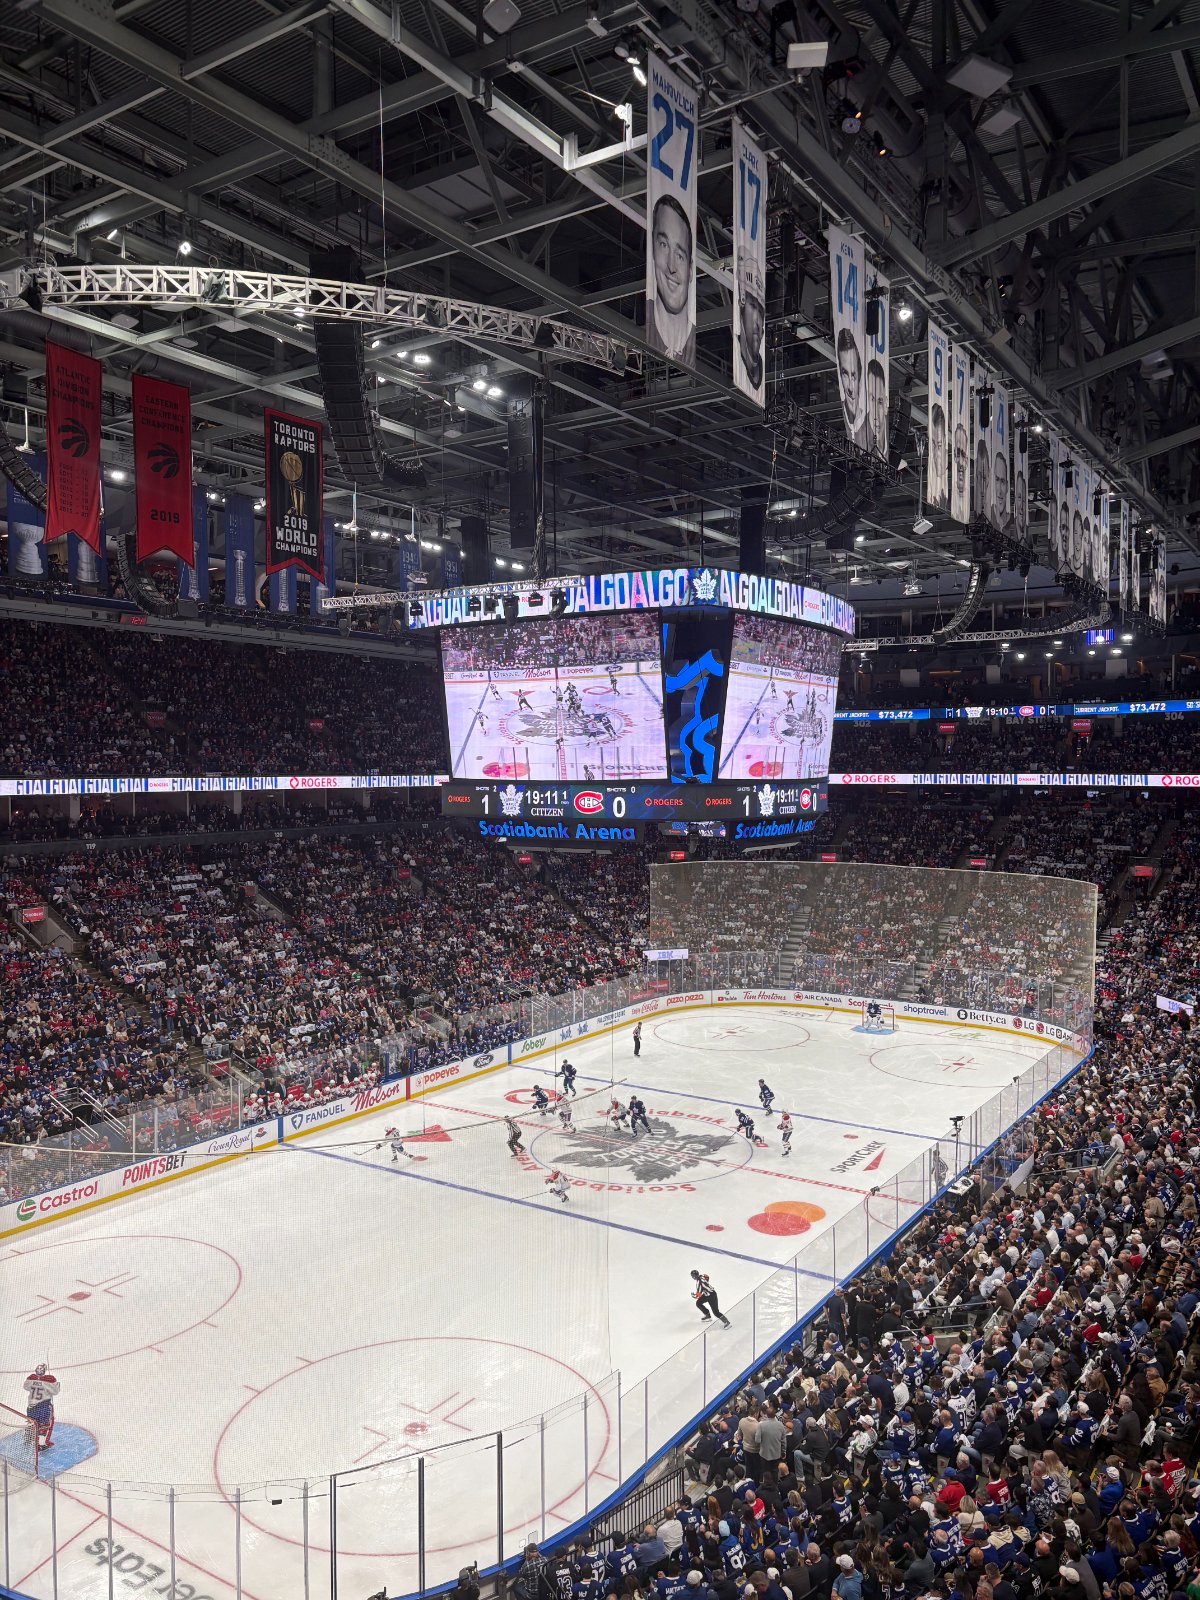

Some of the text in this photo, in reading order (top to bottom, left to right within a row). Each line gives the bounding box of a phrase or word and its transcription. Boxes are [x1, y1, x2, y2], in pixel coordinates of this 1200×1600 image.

[651, 68, 694, 117] MAHOVLICH
[651, 92, 694, 191] 27
[739, 158, 761, 241] 17
[835, 253, 859, 323] 14
[934, 347, 943, 398] 9
[955, 366, 965, 416] 7
[274, 421, 315, 442] TORONTO
[274, 433, 316, 454] RAPTORS
[150, 508, 180, 525] 2019
[283, 515, 309, 531] 2019
[275, 526, 318, 547] WORLD
[275, 542, 318, 557] CHAMPIONS
[956, 709, 961, 717] 1
[985, 708, 1009, 716] 19:10
[1040, 707, 1046, 715] 0
[1129, 701, 1166, 711] $73,472
[878, 711, 913, 720] $73,472
[1006, 717, 1024, 725] BAY
[1165, 711, 1184, 719] 304
[302, 778, 338, 788] ROGERS
[855, 775, 896, 784] ROGERS
[493, 785, 497, 793] 2
[562, 791, 567, 800] 1
[630, 786, 636, 794] 0
[525, 790, 558, 806] 19:11
[653, 798, 683, 806] ROGERS
[711, 798, 733, 806] ROGERS
[776, 789, 795, 804] 19:11
[812, 792, 817, 812] 0
[481, 794, 489, 815] 1
[612, 796, 626, 818] 0
[742, 794, 750, 817] 1
[531, 807, 564, 817] CITIZEN
[479, 820, 635, 841] Scotiabank Arena
[734, 819, 794, 840] Scotiabank
[657, 951, 674, 959] IBM
[667, 993, 704, 1007] pizza pizza
[743, 990, 787, 1002] Tim Hortons
[815, 996, 842, 1004] CANADA
[903, 1003, 947, 1017] shoptravel
[969, 1011, 1007, 1025] Betty.ca
[1023, 1022, 1035, 1031] LG
[1045, 1029, 1055, 1038] LG
[351, 1083, 400, 1112] Molson
[305, 1103, 346, 1124] FANDUEL
[208, 1140, 231, 1153] Crown
[830, 1140, 887, 1174] SPORTCHEK
[122, 1151, 187, 1186] POINTSBET
[39, 1181, 99, 1212] Castrol
[31, 1387, 43, 1400] 75
